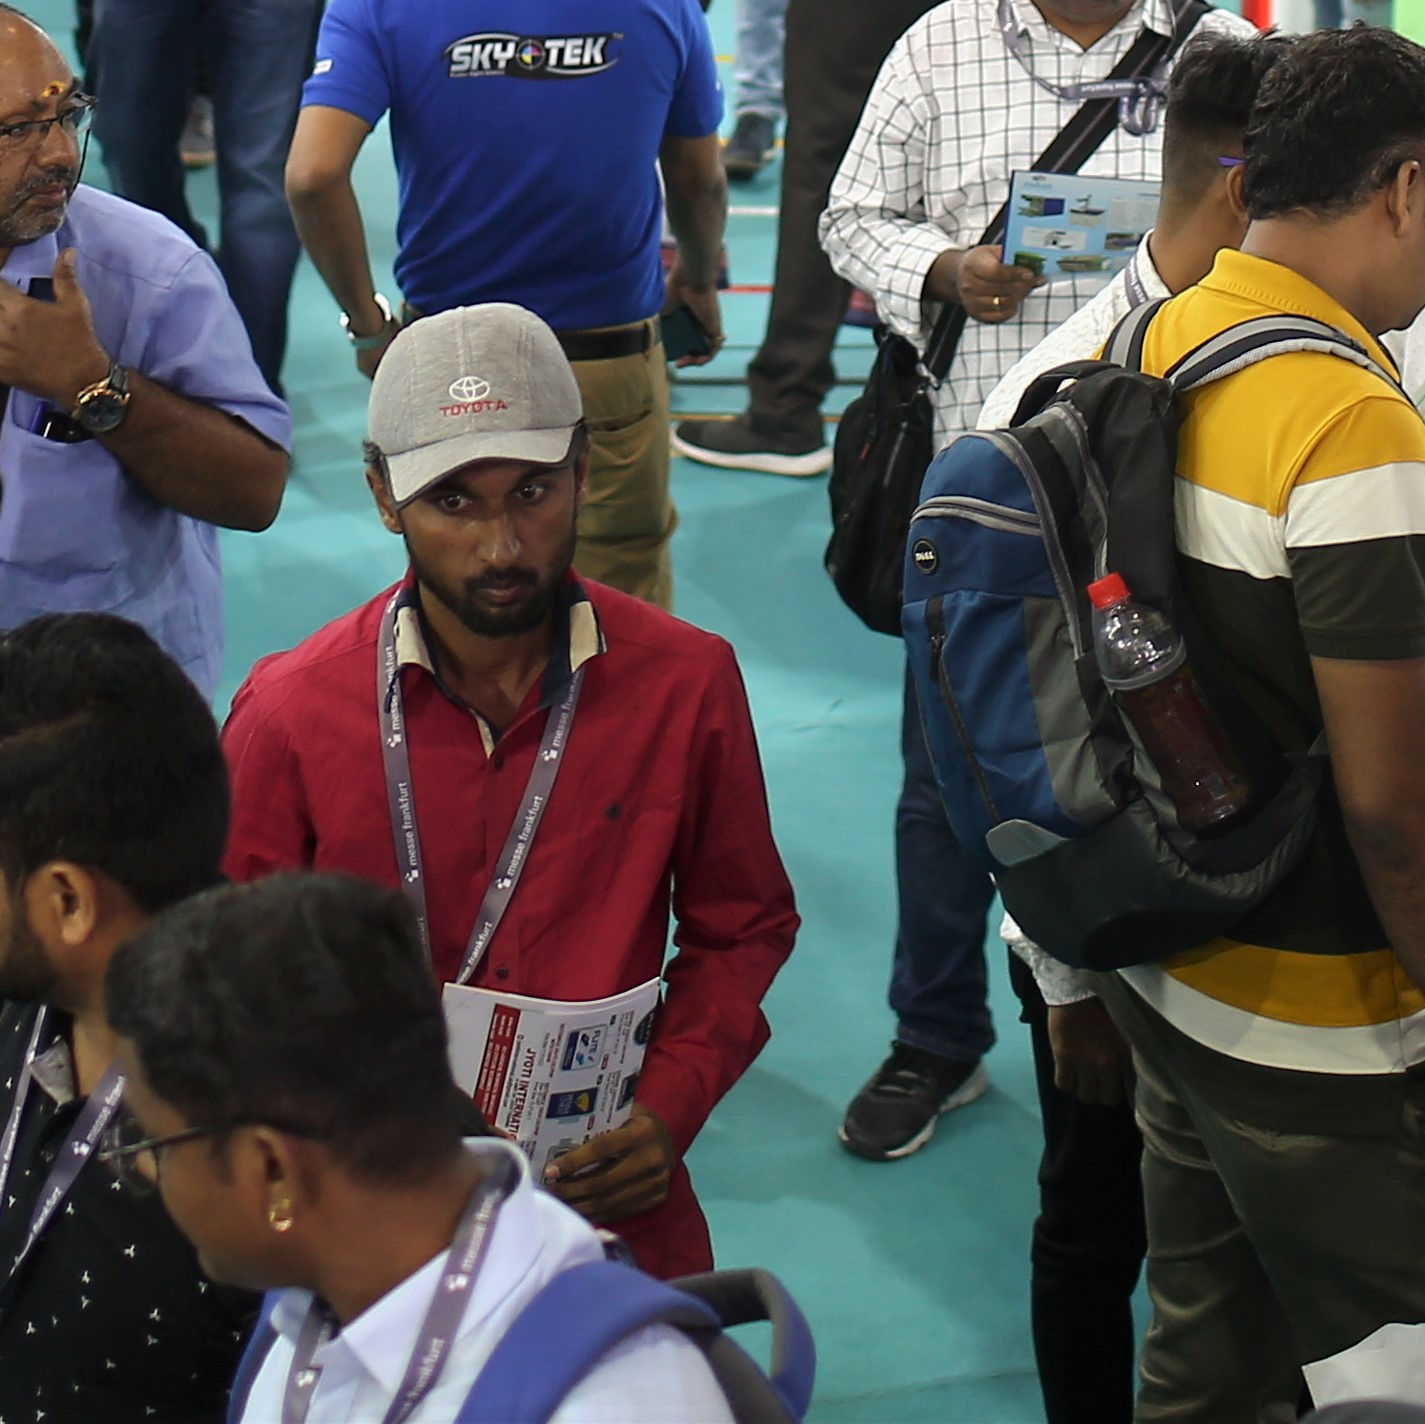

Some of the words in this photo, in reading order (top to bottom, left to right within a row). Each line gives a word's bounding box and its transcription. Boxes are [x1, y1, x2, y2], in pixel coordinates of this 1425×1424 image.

[544, 36, 607, 66] TEK
[439, 399, 508, 418] TOYOTA
[552, 710, 569, 748] messe
[398, 781, 414, 829] frankfurt
[407, 830, 418, 866] messe
[505, 834, 527, 876] messe
[520, 795, 544, 836] frankfurt
[468, 920, 493, 967] frankfurt
[521, 1047, 536, 1078] JYOTI
